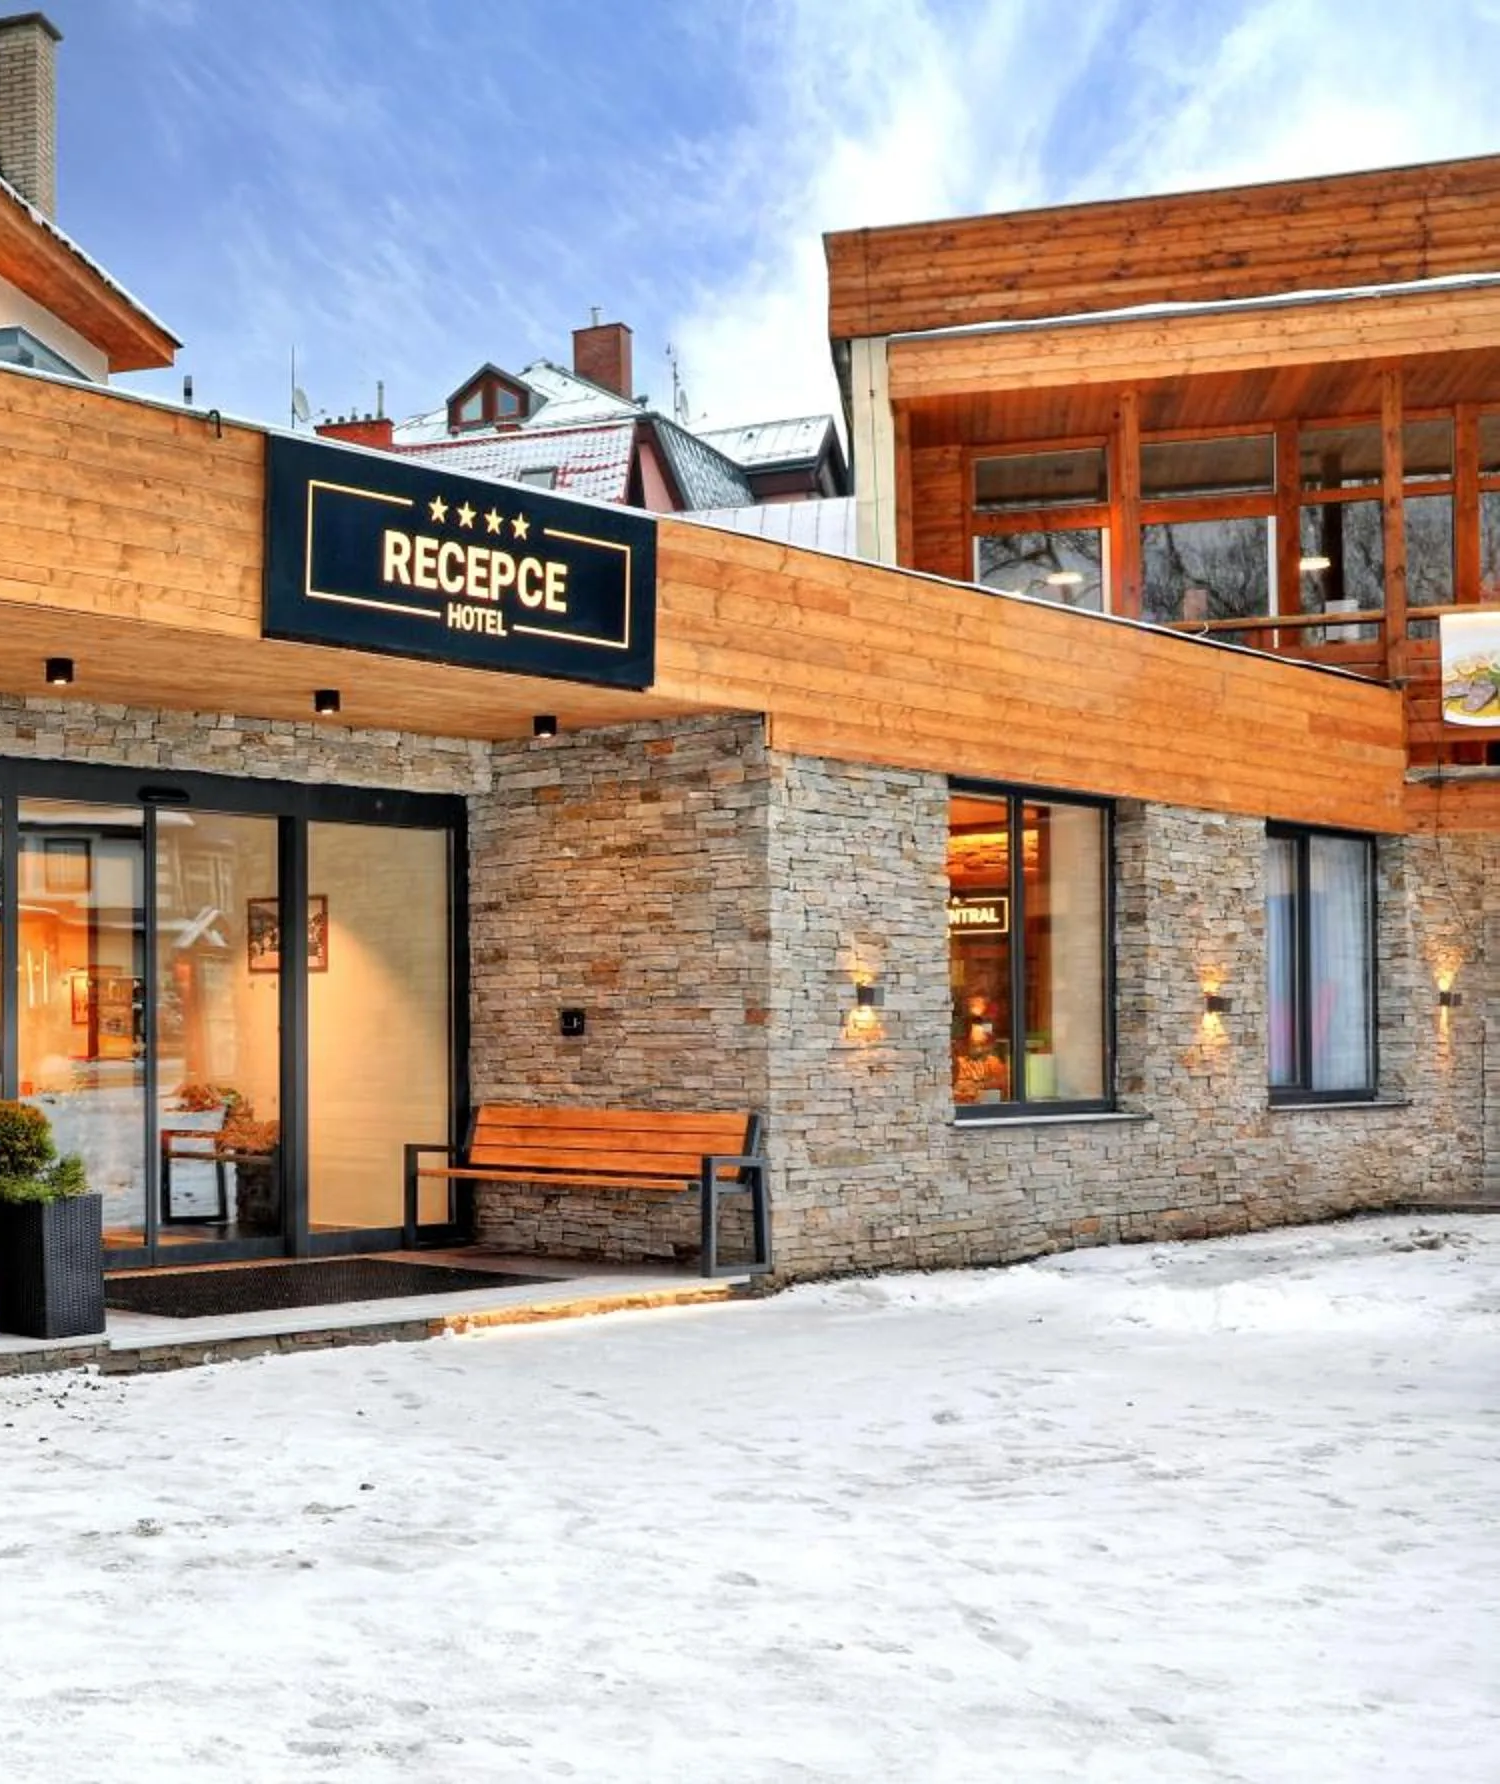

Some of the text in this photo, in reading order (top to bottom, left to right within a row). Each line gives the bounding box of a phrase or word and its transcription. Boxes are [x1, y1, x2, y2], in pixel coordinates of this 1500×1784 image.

[383, 529, 568, 613] RECEPCE
[447, 602, 508, 637] HOTEL
[946, 907, 1000, 924] NTRAL
